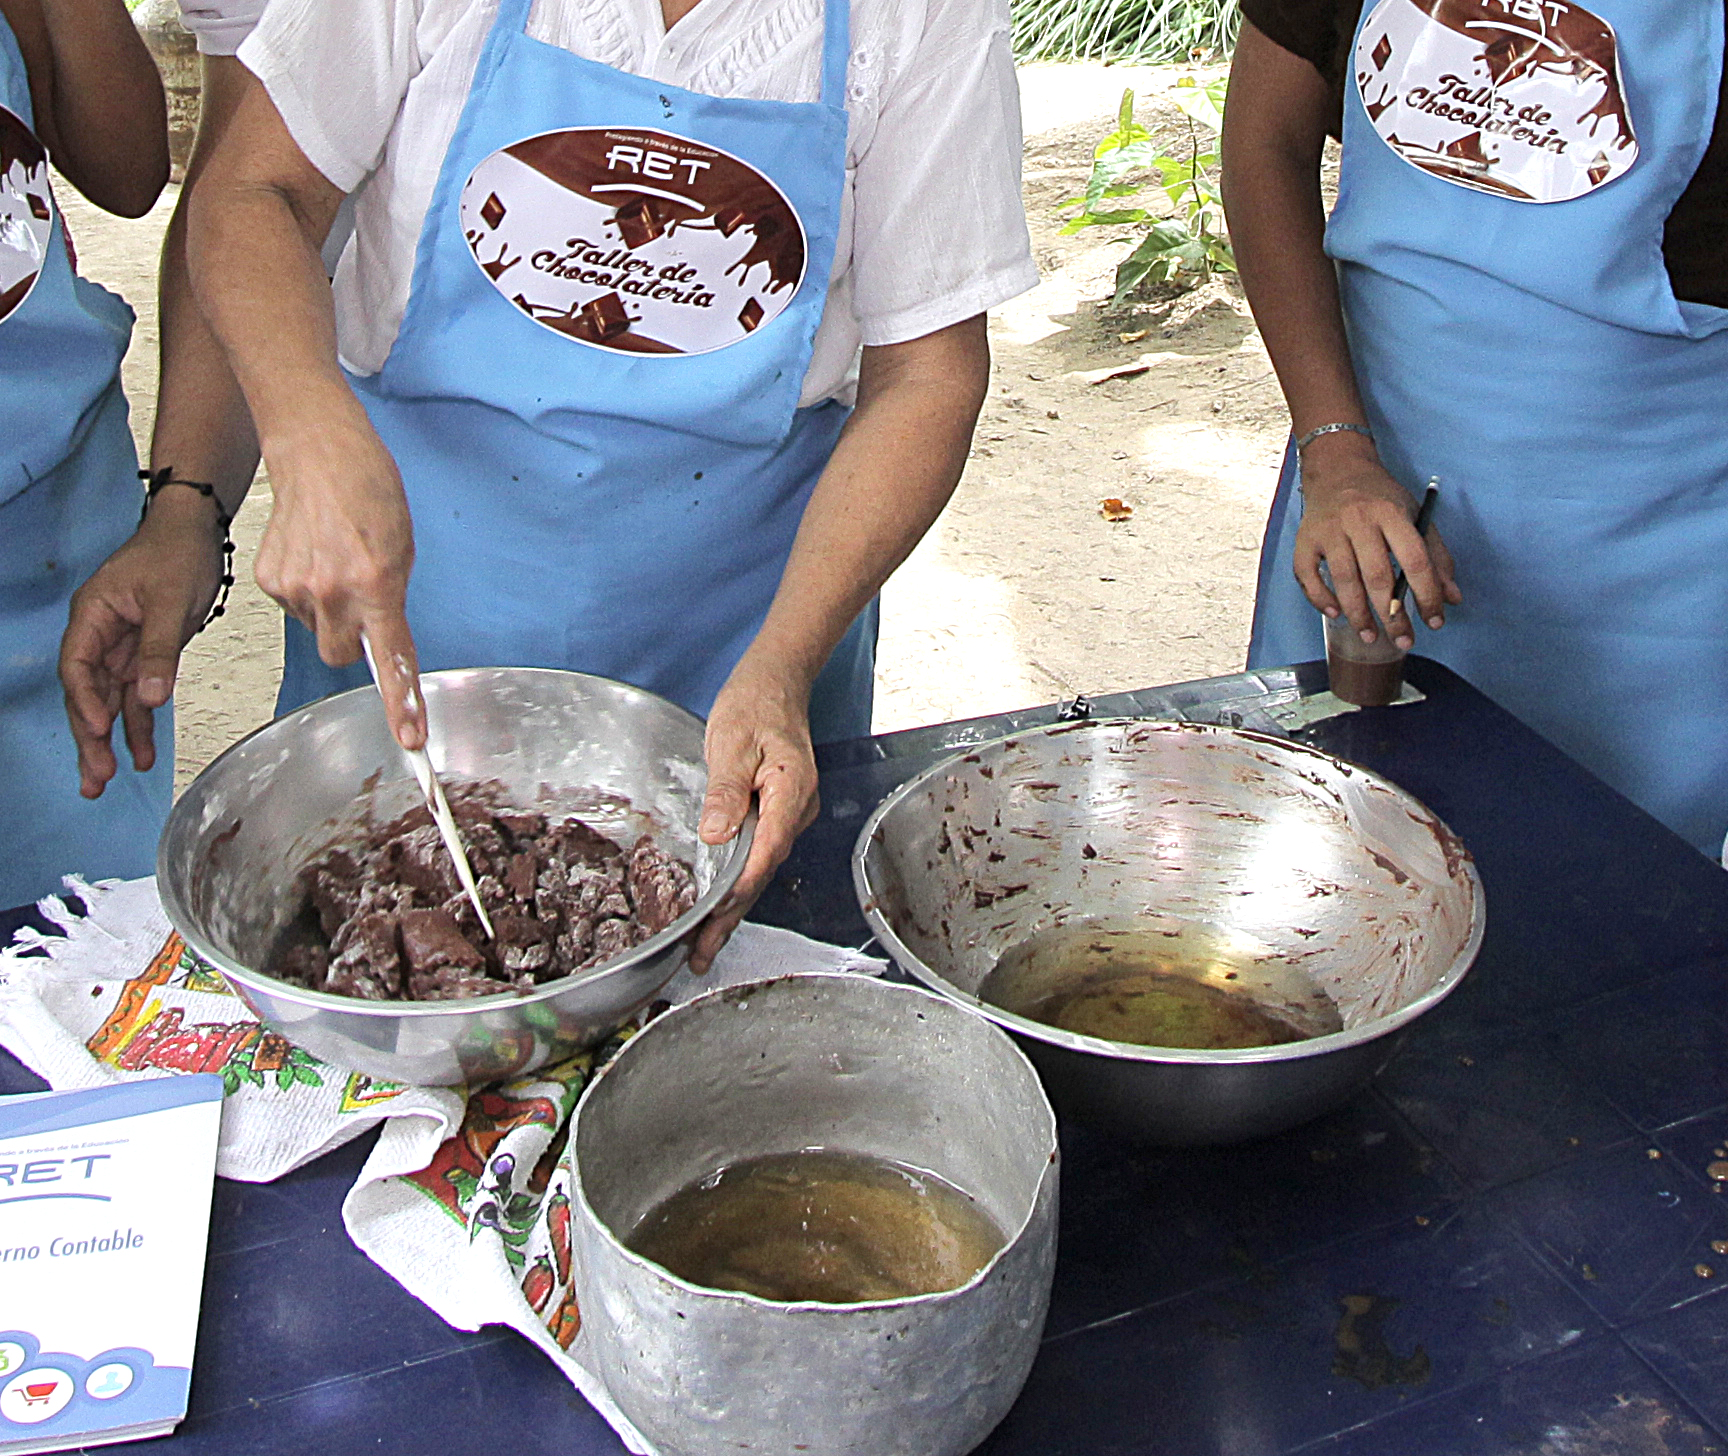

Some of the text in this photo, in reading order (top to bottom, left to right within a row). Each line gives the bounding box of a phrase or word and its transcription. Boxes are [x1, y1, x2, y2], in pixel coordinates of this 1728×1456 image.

[1438, 73, 1552, 127] Taller de
[606, 145, 711, 184] RET
[566, 238, 698, 283] Taller de
[49, 1227, 145, 1257] Contable
